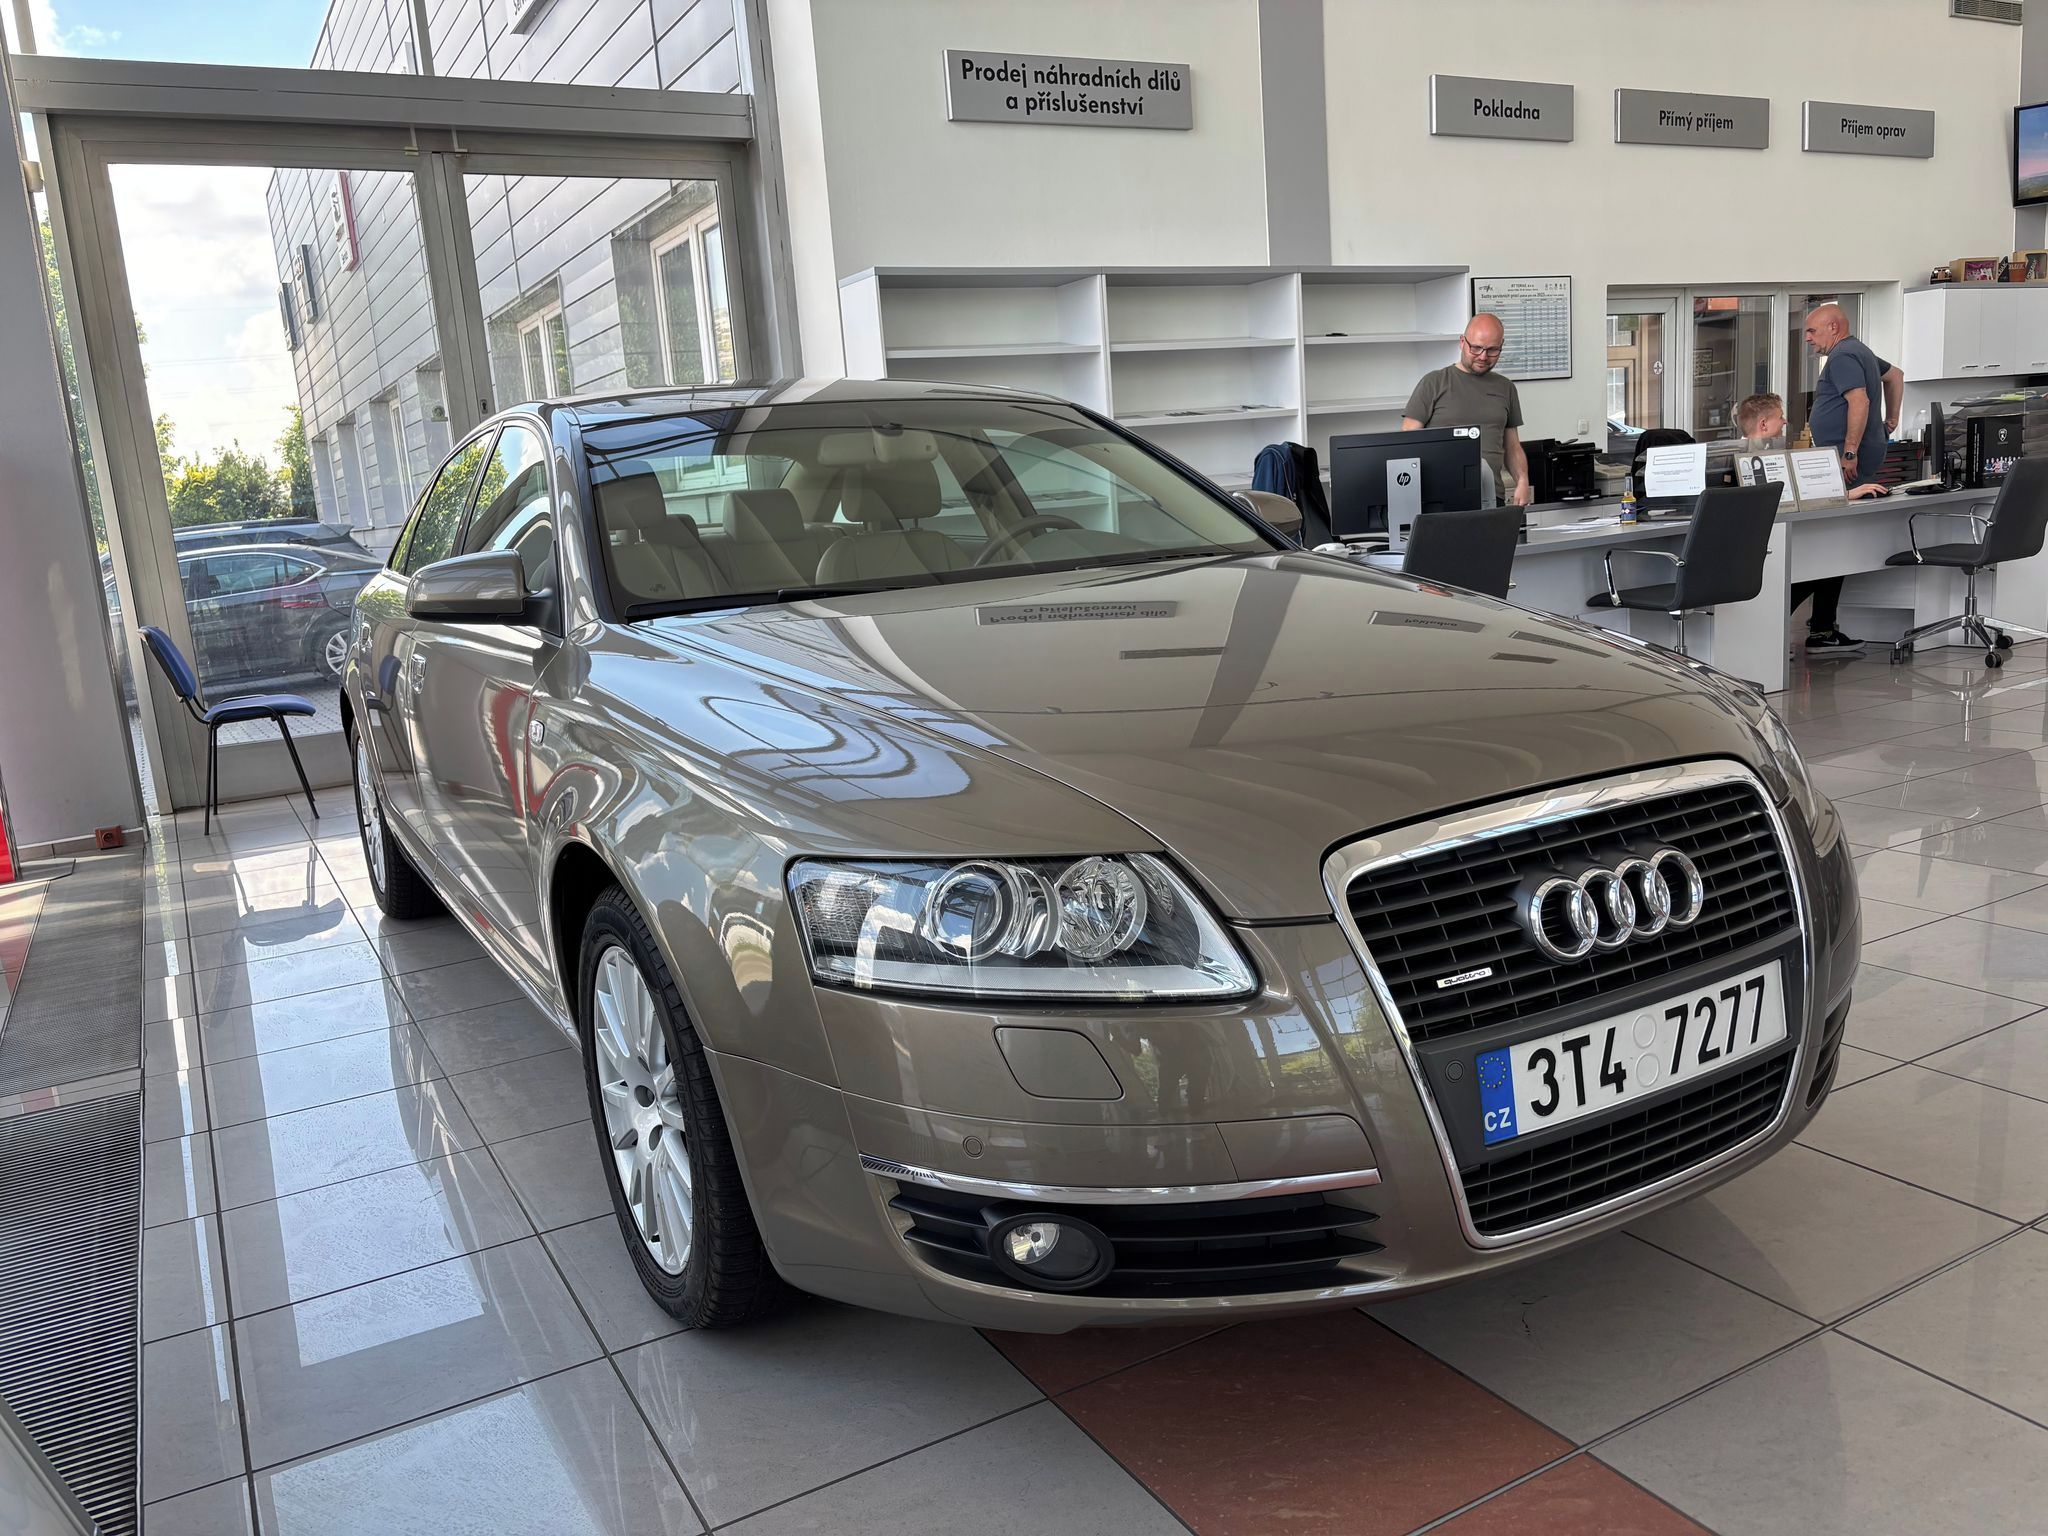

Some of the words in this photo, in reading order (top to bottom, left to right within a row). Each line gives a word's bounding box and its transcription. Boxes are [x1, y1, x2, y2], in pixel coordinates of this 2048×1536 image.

[961, 58, 1027, 88] Prodej
[1034, 64, 1141, 89] náhradních
[1147, 69, 1181, 92] dílů
[1005, 94, 1018, 110] a
[1025, 91, 1144, 115] příslušenství
[1474, 98, 1540, 120] Pokladna
[1659, 109, 1693, 131] Přímý
[1696, 113, 1734, 132] příjem
[1841, 118, 1873, 138] Příjem
[1876, 126, 1906, 139] oprav
[1397, 472, 1411, 486] hp
[1443, 970, 1486, 985] quattro
[1527, 1026, 1627, 1117] 3T4
[1664, 974, 1765, 1075] 7277
[1484, 1106, 1512, 1132] CZ
